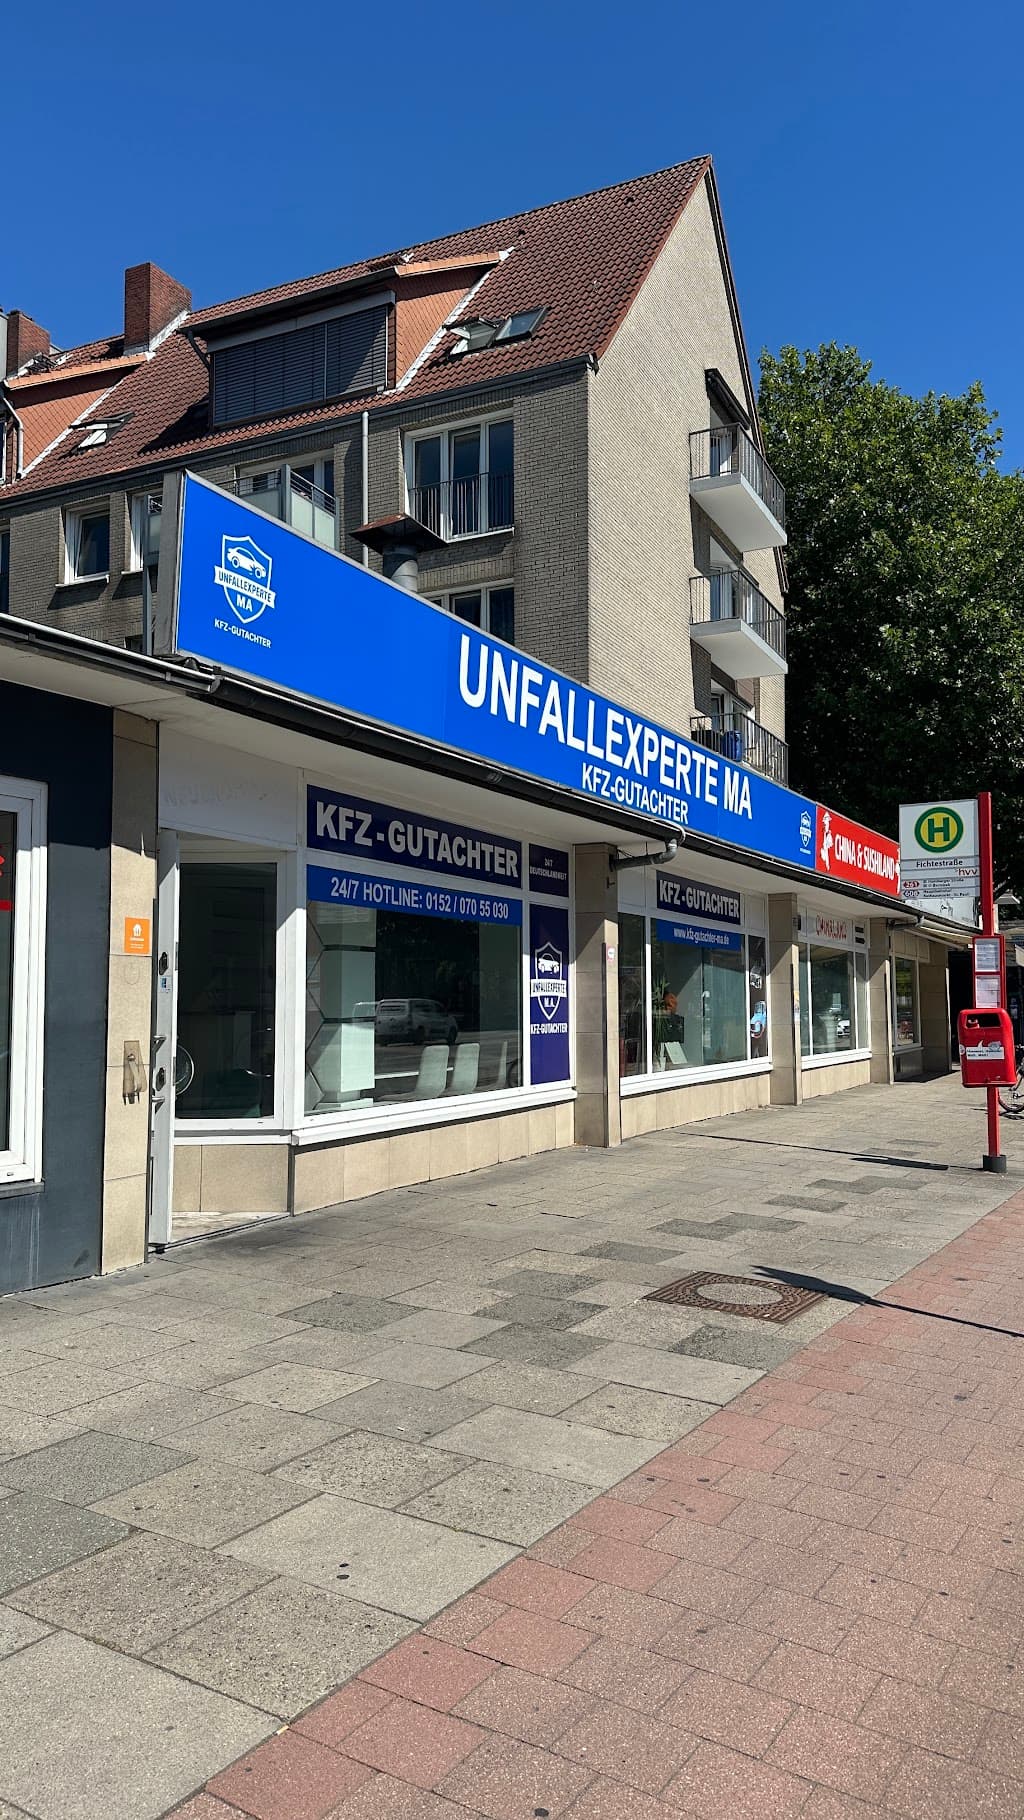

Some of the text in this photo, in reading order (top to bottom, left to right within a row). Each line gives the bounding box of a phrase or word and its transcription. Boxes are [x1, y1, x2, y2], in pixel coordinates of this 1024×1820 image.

[218, 570, 272, 603] UNFALLEXPERTE
[236, 594, 253, 612] MA
[214, 618, 272, 648] KFZ-GUTACHTER
[459, 633, 753, 820] UNFALLEXPERTE MA
[582, 762, 689, 825] KFZ-GUTACHTER
[928, 817, 950, 842] H
[834, 833, 895, 880] CHINA & SUSHILAND
[916, 859, 963, 868] Fichtestraße
[958, 867, 978, 876] hvv
[330, 876, 509, 919] 24/7 HOTLINE: 0152 / 070 55 030
[673, 927, 730, 945] www.kfz-gutachter-ma.de
[533, 981, 565, 994] UNFALLEXPERTE
[530, 1023, 568, 1035] KFZ-GUTACHTER
